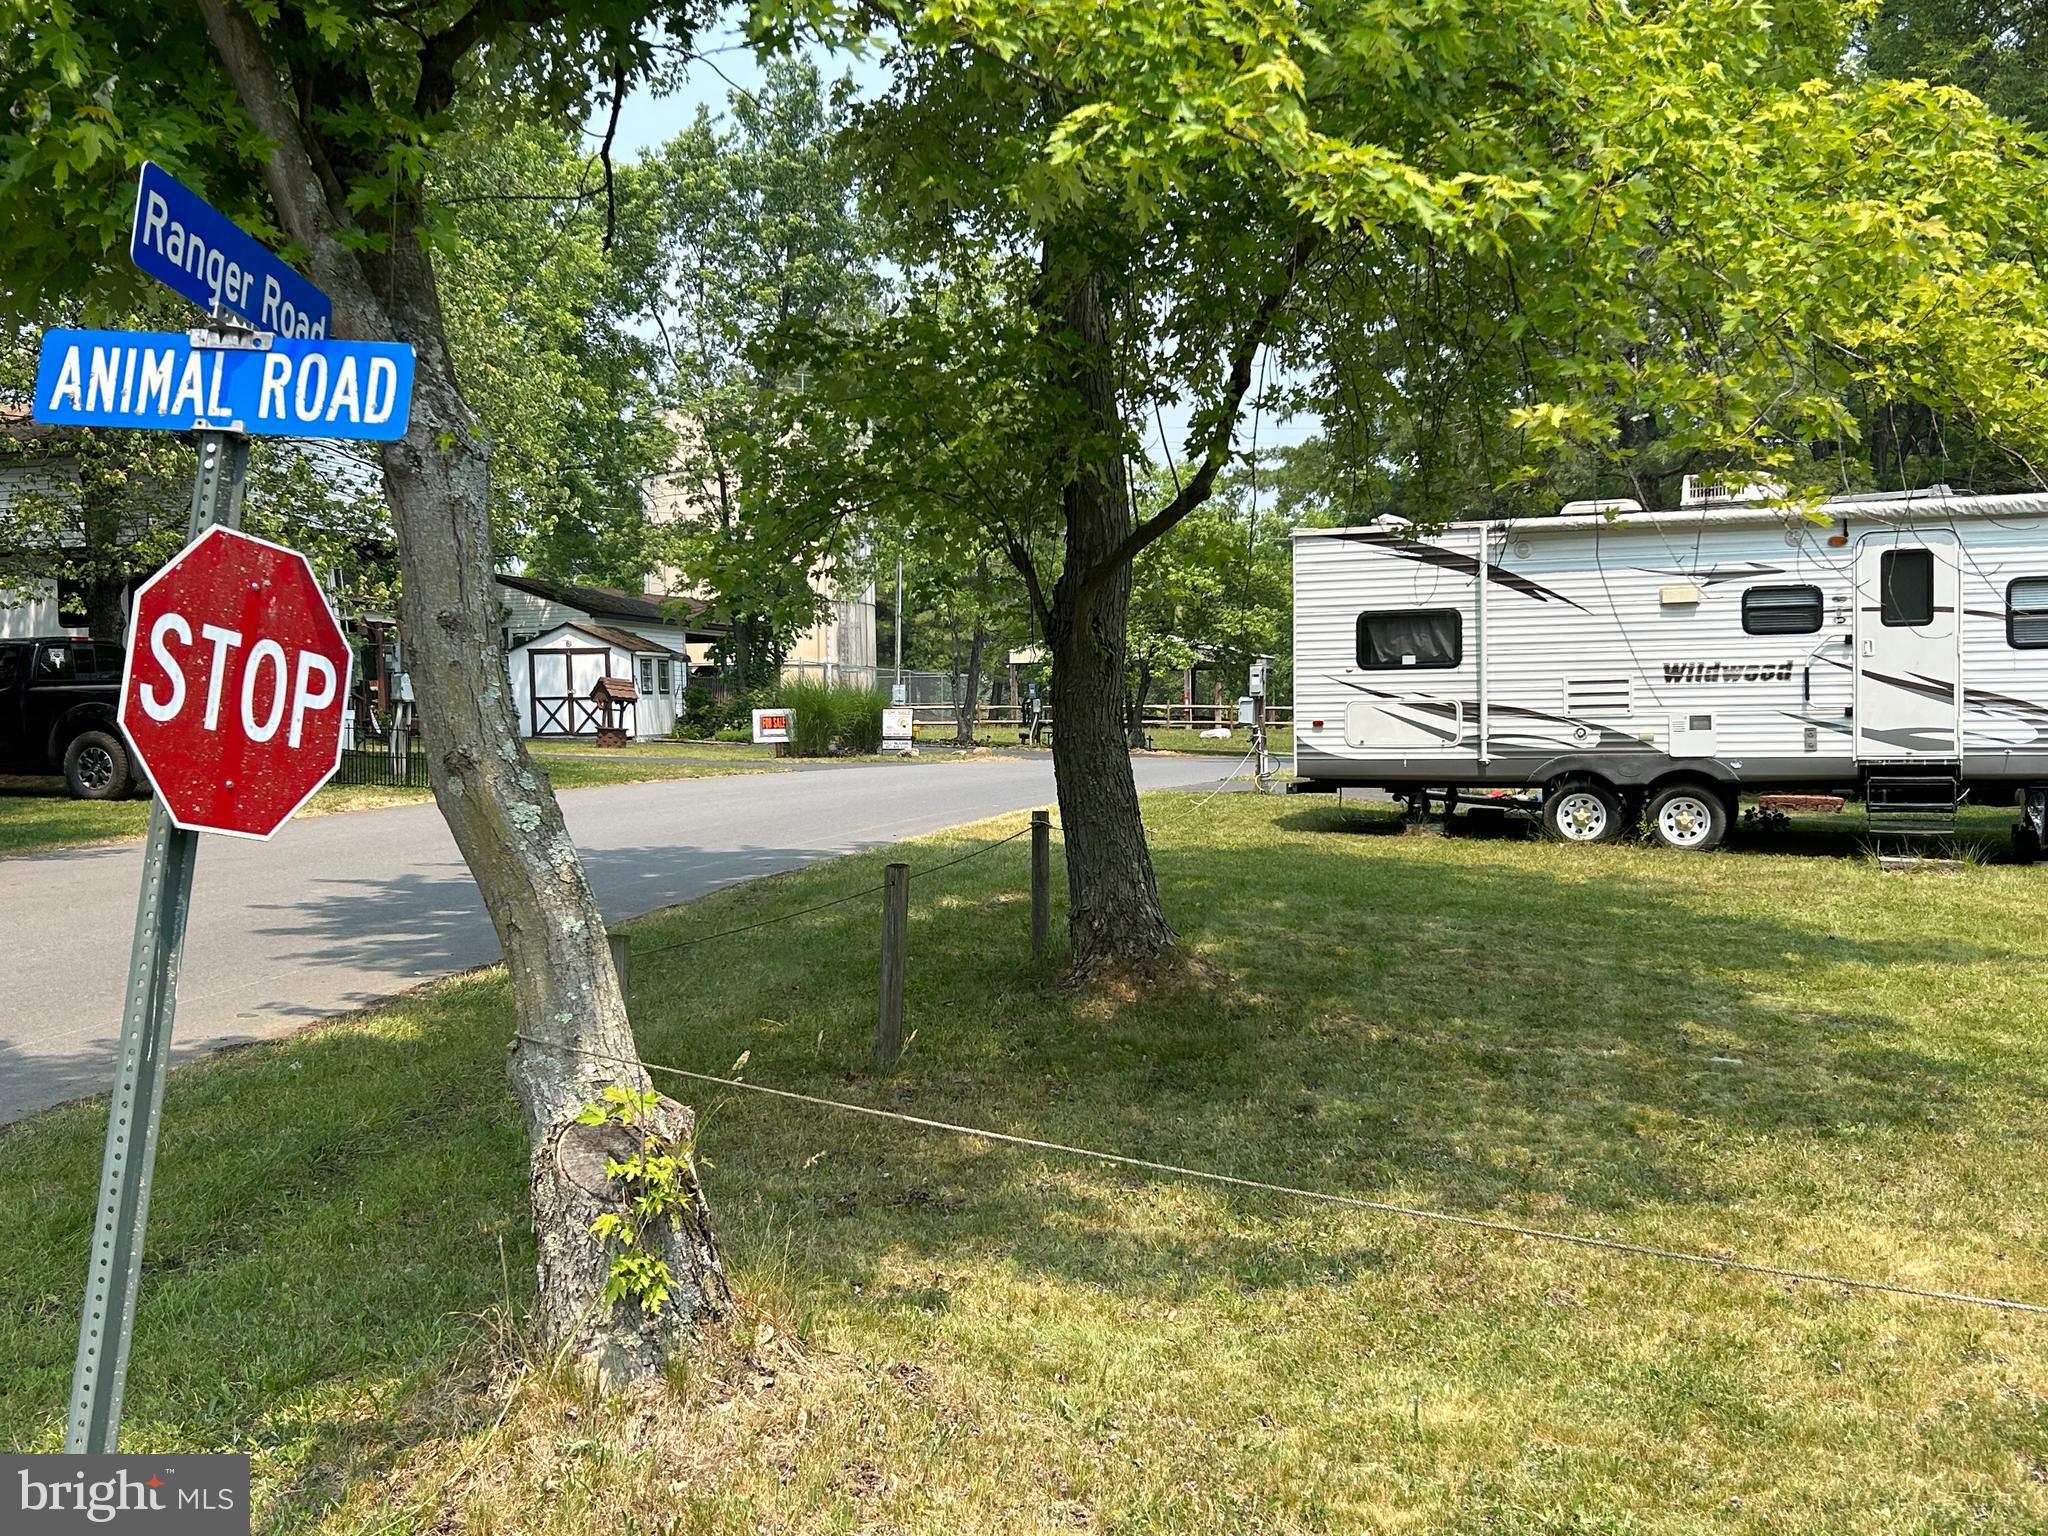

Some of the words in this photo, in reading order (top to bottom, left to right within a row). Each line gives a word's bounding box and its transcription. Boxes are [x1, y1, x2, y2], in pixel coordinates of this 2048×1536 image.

[142, 189, 254, 306] Ranger
[262, 273, 328, 340] Road
[48, 345, 233, 418] ANIMAL
[257, 352, 398, 424] ROAD
[139, 612, 337, 749] STOP
[1662, 660, 1793, 684] Wildwood
[762, 717, 772, 728] FOR
[773, 716, 786, 729] SALE
